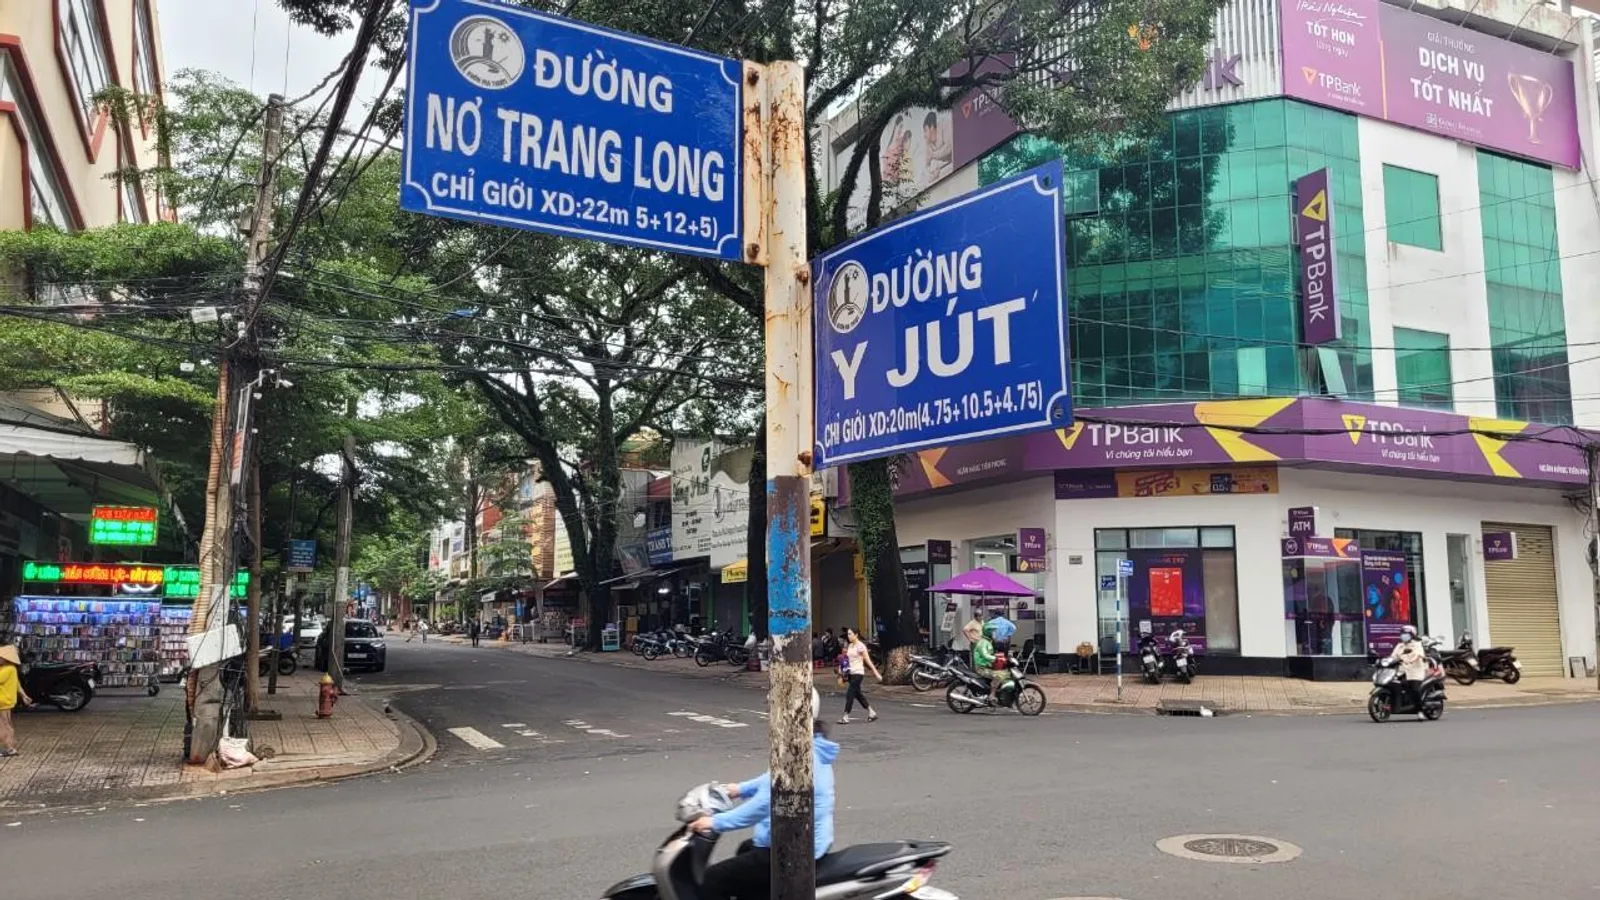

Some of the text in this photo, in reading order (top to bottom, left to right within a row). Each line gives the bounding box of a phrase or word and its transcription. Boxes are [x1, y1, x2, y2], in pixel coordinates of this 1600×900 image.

[534, 49, 673, 113] ĐƯỜNG
[1318, 72, 1362, 97] TPBank
[1418, 46, 1485, 87] DỊCH VỤ
[1410, 75, 1494, 118] TỐT NHẤT
[426, 93, 725, 202] NƠ TRANG LONG
[431, 168, 719, 241] CHỈ GIỚI XD:22m 5+12+5)
[871, 244, 982, 313] ĐƯỜNG
[1304, 224, 1329, 324] TPBank
[830, 297, 1026, 400] Y JÚT
[824, 412, 840, 448] CHỈ
[842, 408, 866, 441] GIỚI
[1088, 422, 1184, 446] TPBank
[1176, 448, 1193, 458] bạn
[1292, 521, 1311, 531] ATM
